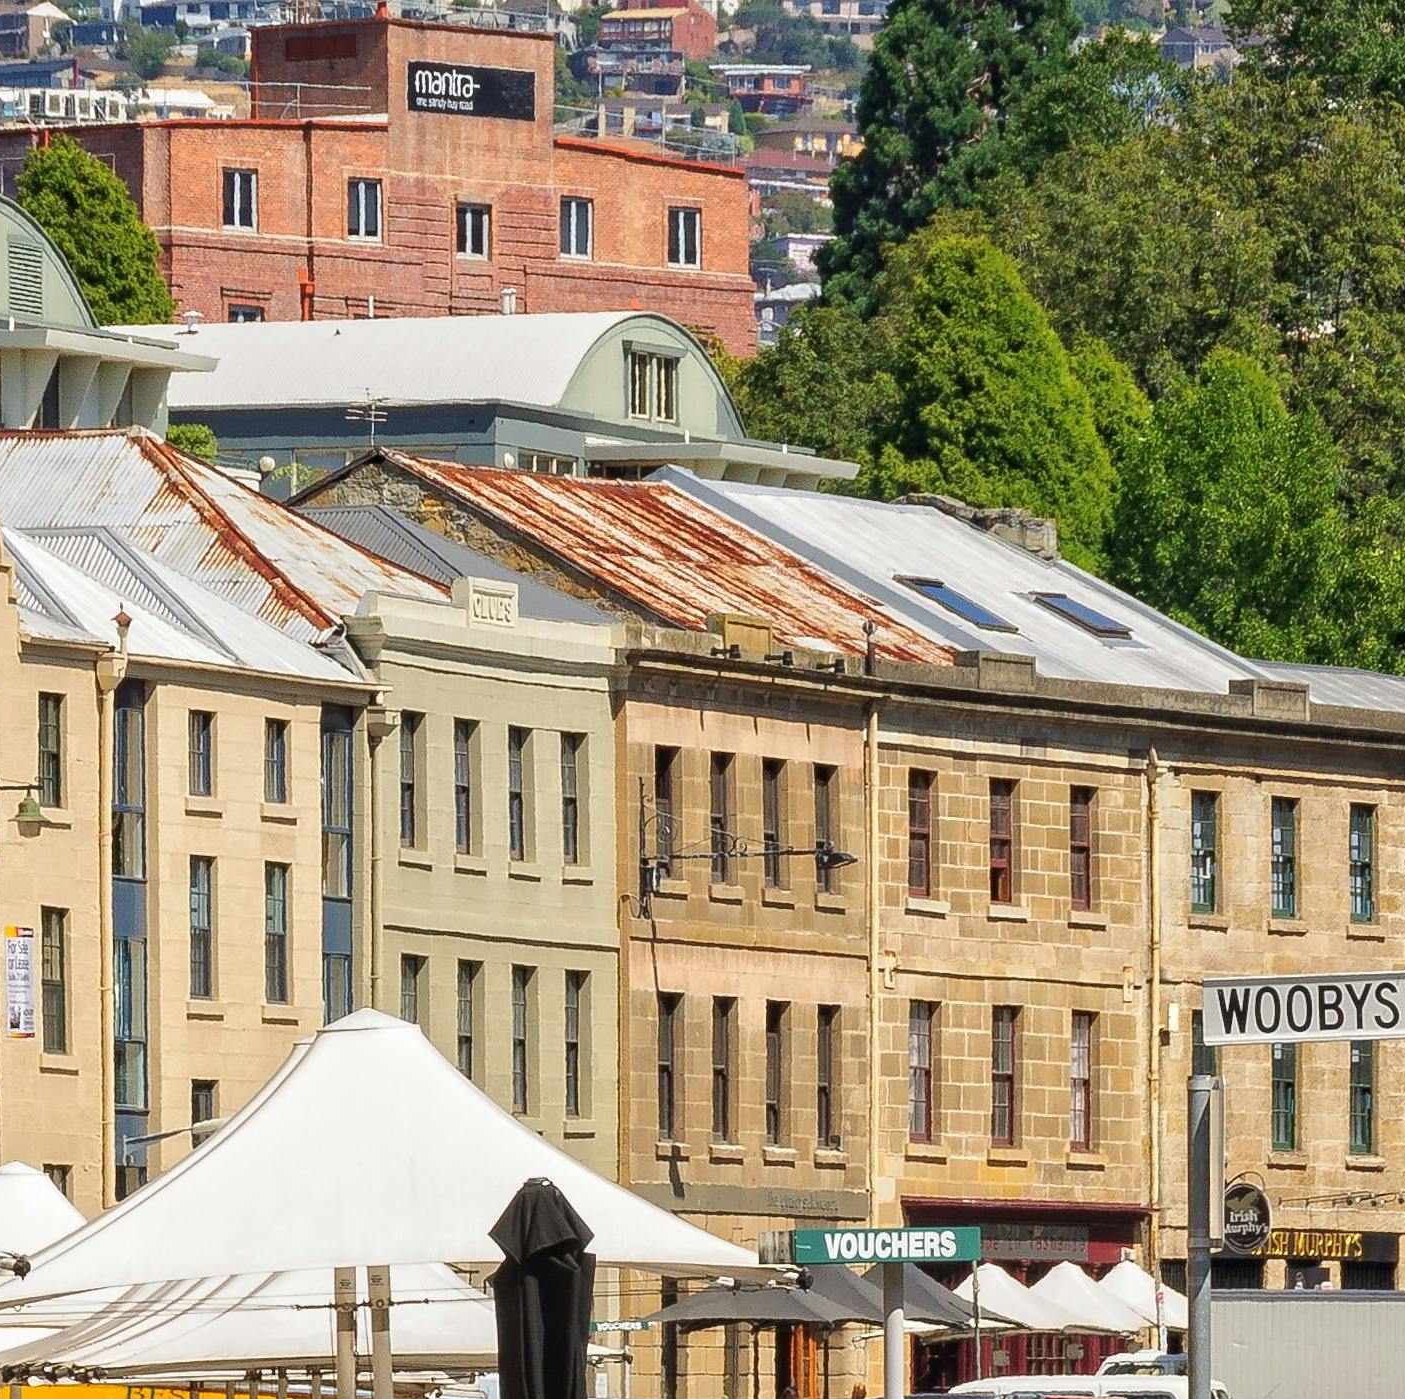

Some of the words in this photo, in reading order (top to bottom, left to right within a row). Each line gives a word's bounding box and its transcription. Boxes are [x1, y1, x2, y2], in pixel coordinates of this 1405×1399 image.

[415, 69, 477, 98] mantra
[1217, 983, 1400, 1035] WOOBYS
[1229, 1209, 1259, 1223] Irish
[824, 1231, 957, 1259] VOUCHERS
[1294, 1231, 1363, 1257] MURPHY'S
